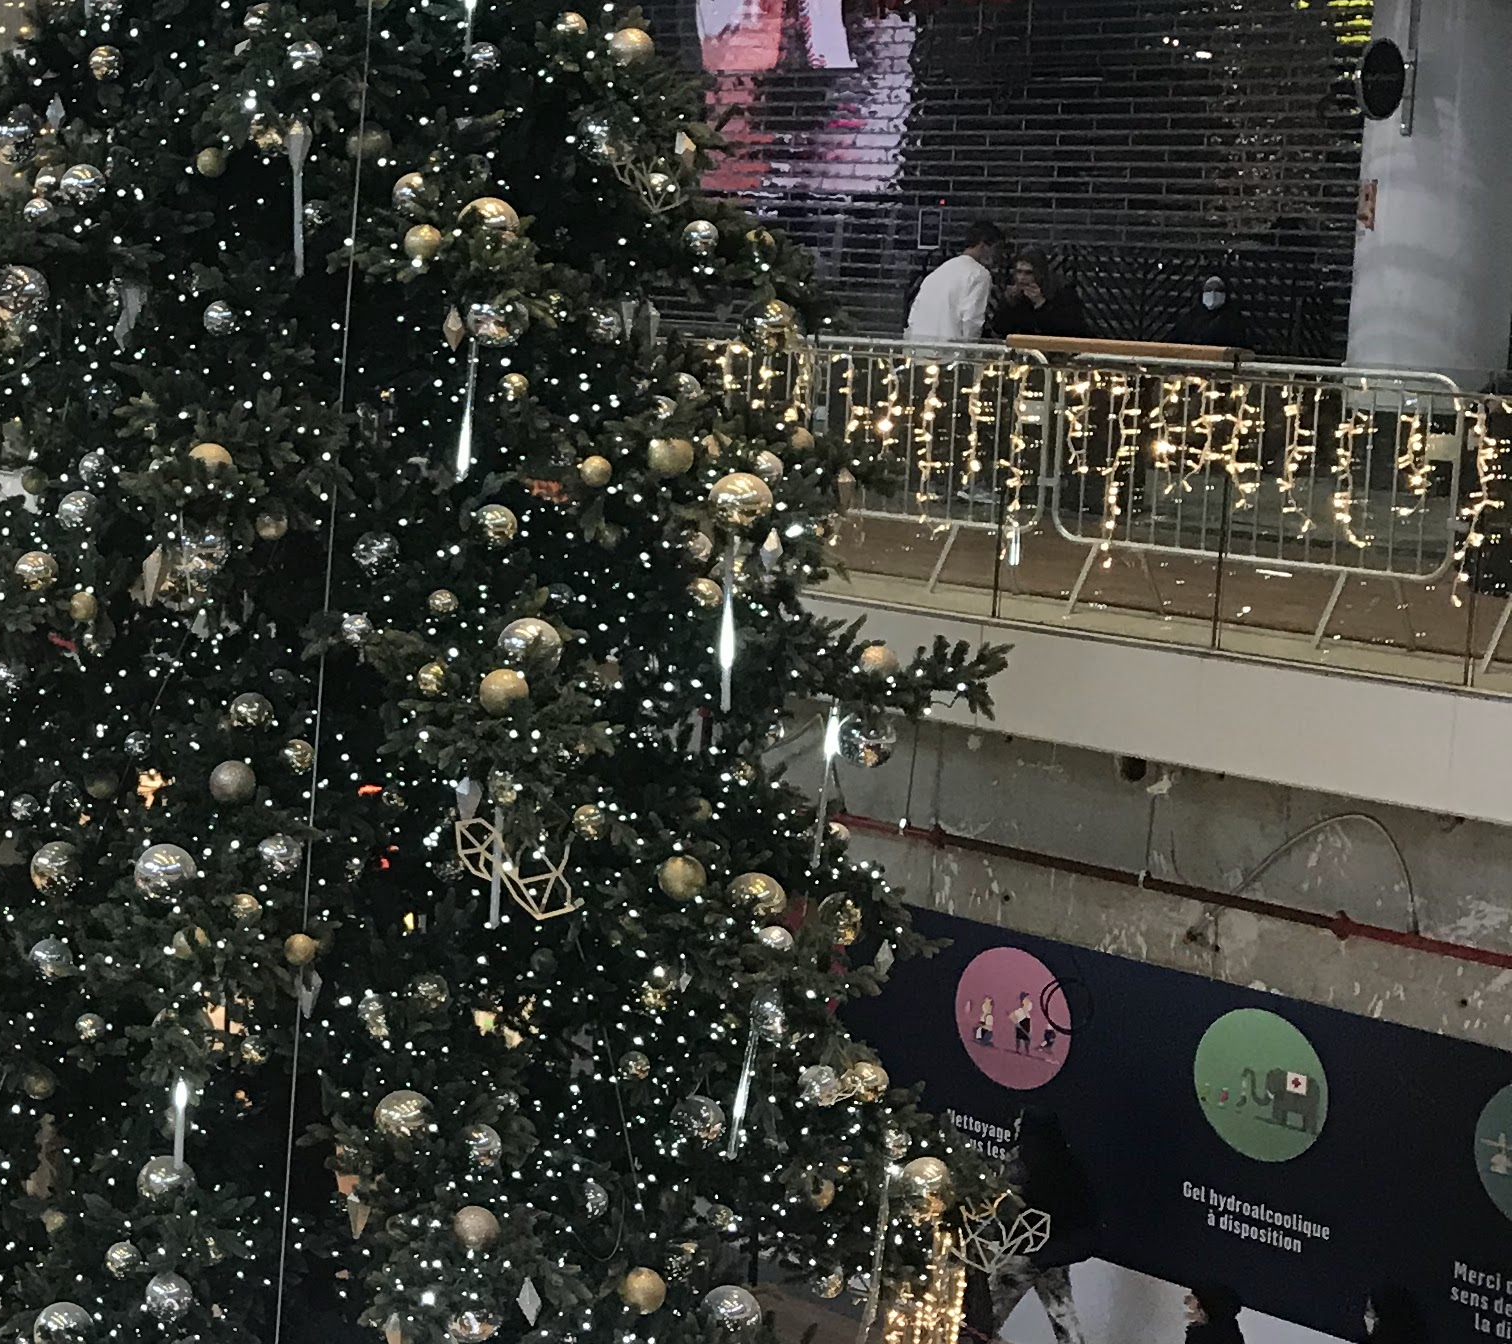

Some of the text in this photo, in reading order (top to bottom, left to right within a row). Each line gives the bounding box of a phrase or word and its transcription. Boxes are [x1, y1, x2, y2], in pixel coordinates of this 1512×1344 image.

[987, 1141, 1006, 1160] les
[1183, 1181, 1330, 1240] Gel hydroalcoolique
[1207, 1209, 1302, 1253] à disposition
[1454, 1261, 1501, 1291] Merci
[1450, 1286, 1489, 1310] sens
[1475, 1313, 1491, 1333] la
